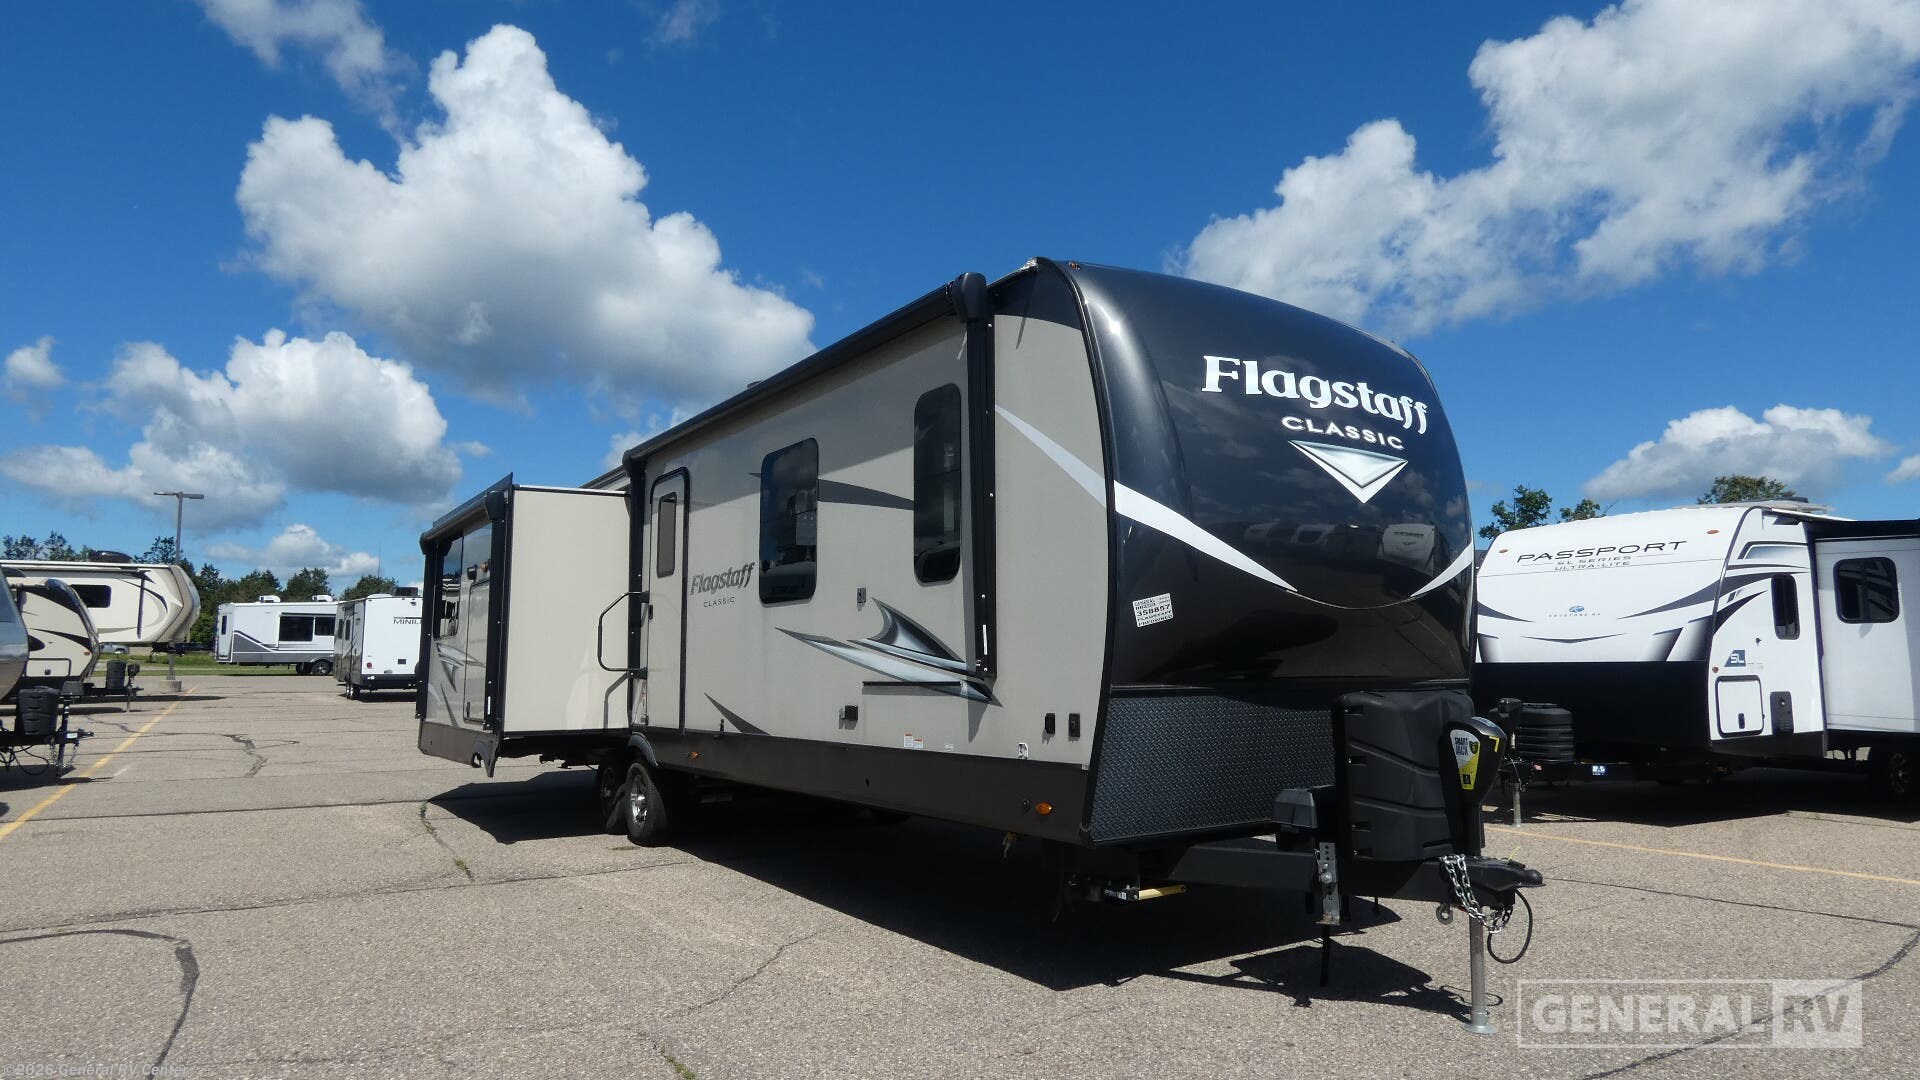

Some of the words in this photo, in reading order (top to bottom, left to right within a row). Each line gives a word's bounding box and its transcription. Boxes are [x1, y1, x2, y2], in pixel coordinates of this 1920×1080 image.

[1201, 355, 1428, 435] Flagstaff
[1281, 416, 1405, 450] CLASSIC
[1516, 541, 1688, 563] PASSPORT
[1578, 555, 1632, 564] SERIES
[1554, 561, 1631, 571] ULTRA-LITE
[690, 562, 756, 595] Flagstaff
[703, 596, 736, 608] CLASSIC
[1730, 653, 1745, 664] SL
